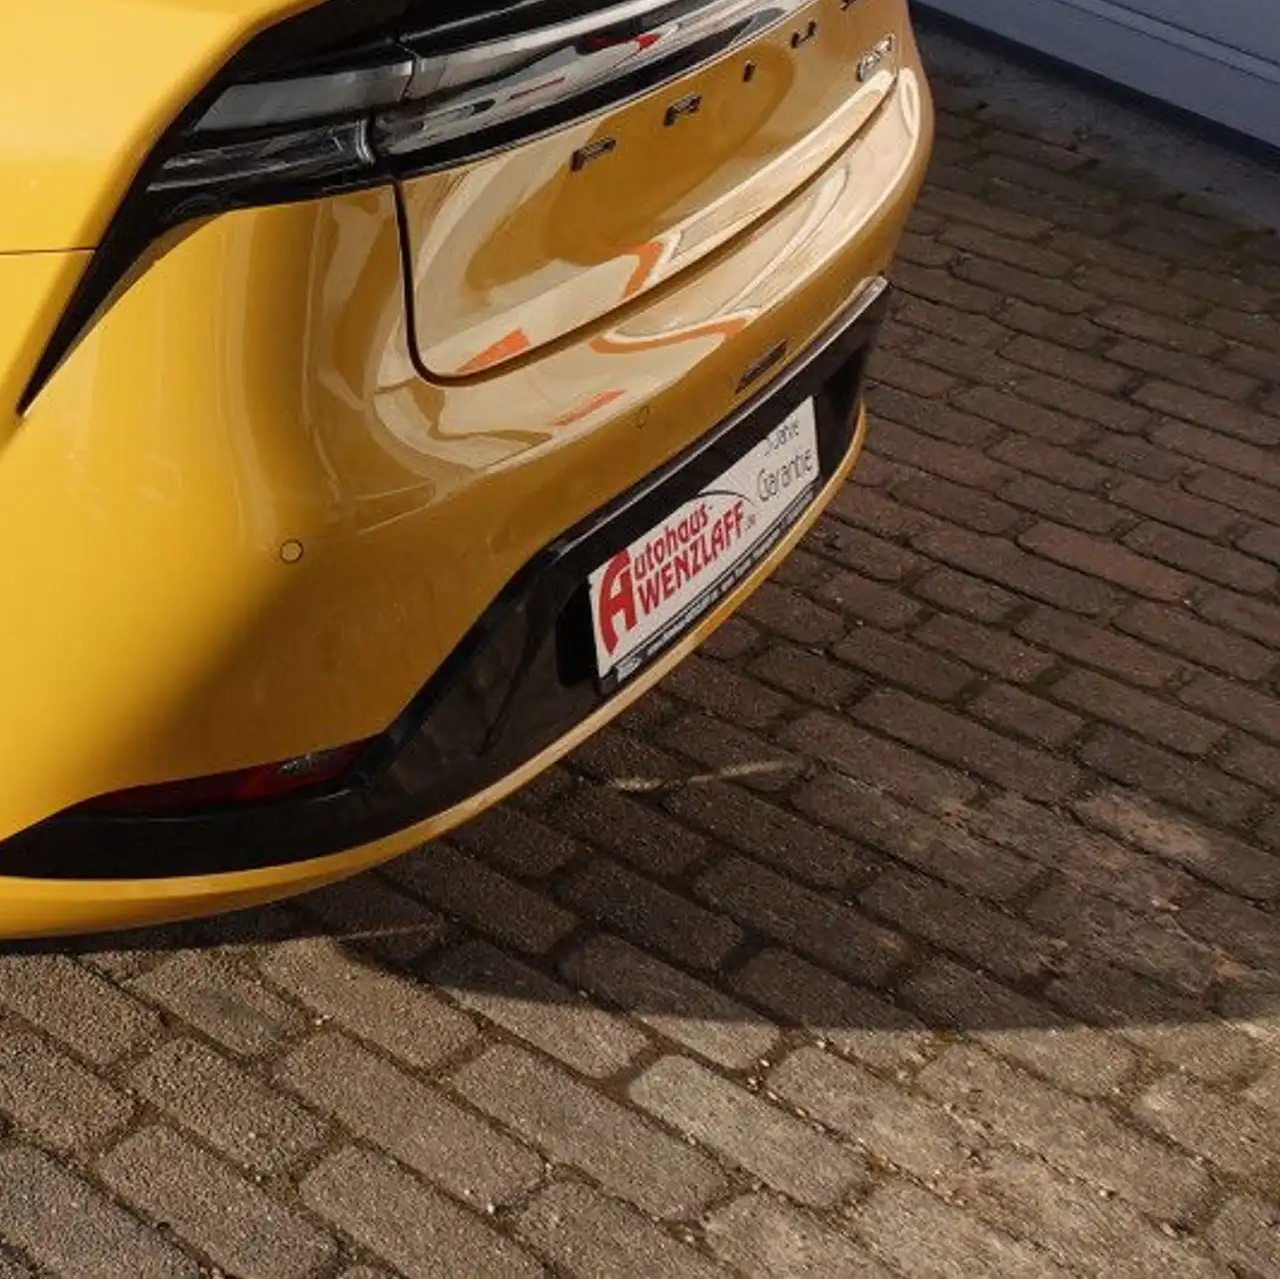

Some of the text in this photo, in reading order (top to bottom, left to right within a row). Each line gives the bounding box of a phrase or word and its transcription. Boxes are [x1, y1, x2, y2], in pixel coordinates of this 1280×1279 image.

[756, 447, 813, 503] Garantie
[599, 503, 710, 656] Autohaus
[638, 499, 744, 617] WENZLAFF
